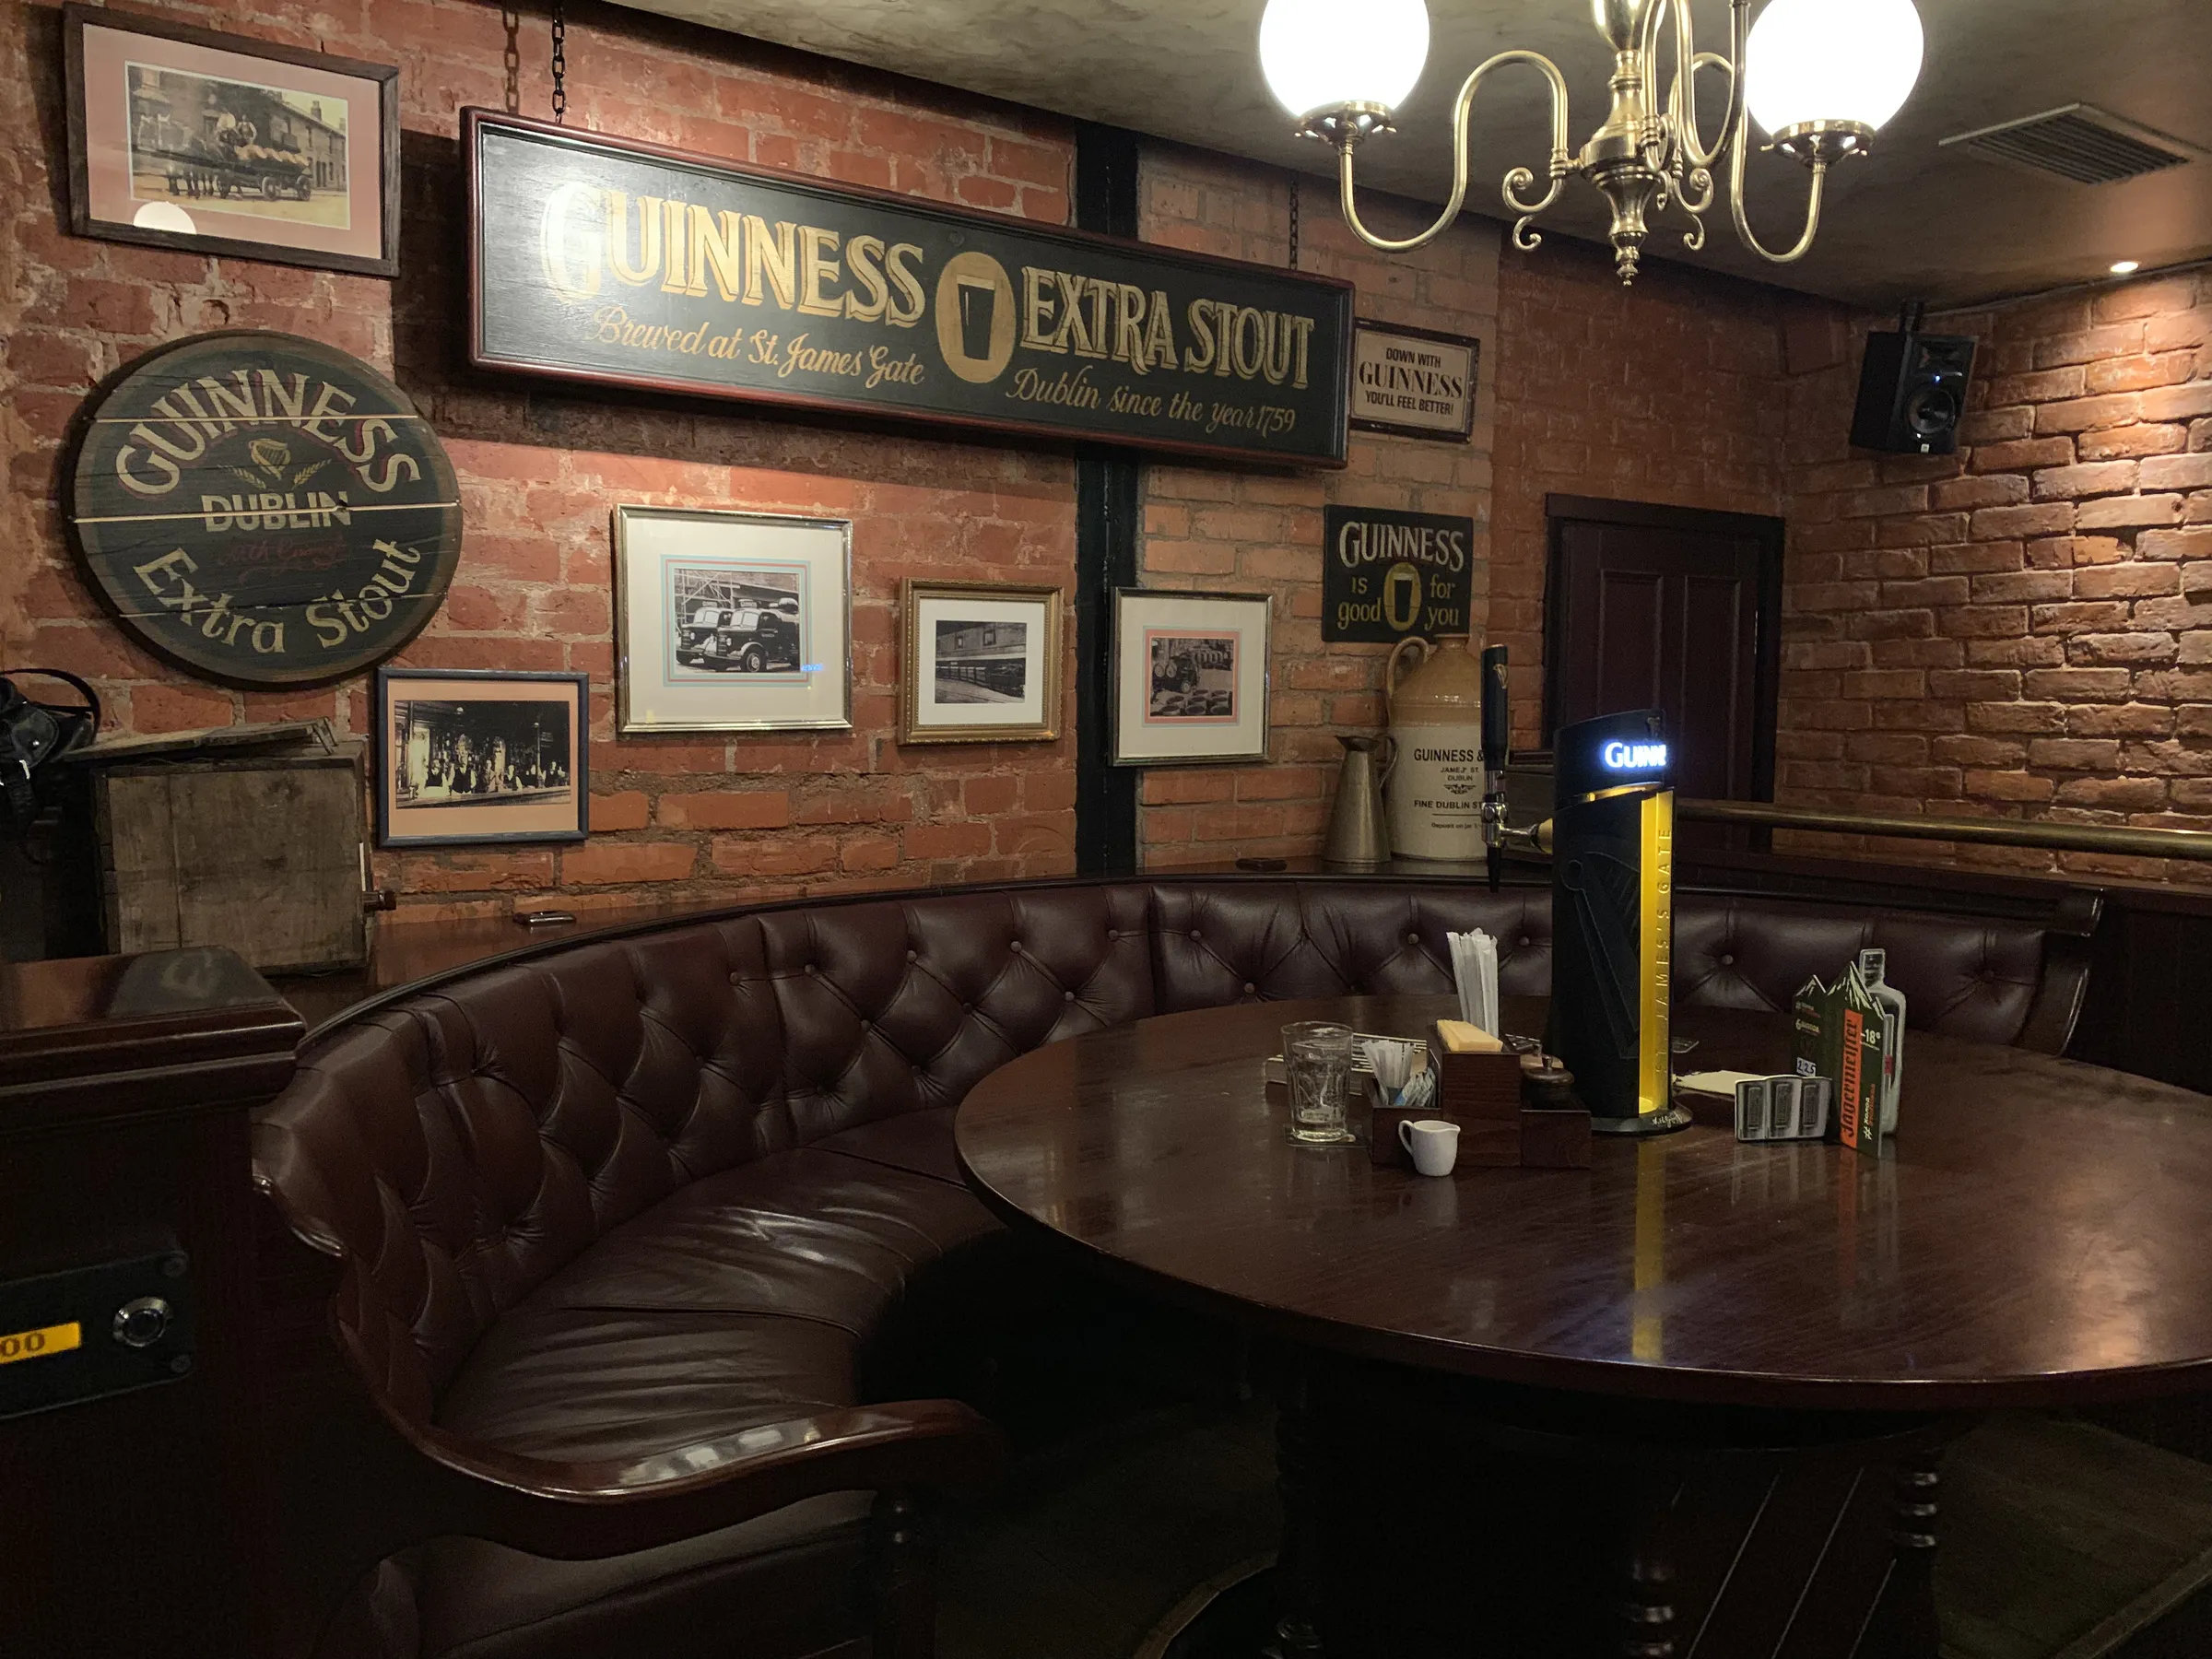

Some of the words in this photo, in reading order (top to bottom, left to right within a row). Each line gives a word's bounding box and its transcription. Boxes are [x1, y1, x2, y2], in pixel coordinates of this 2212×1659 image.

[540, 172, 925, 329] GUINNESS
[1020, 265, 1178, 375] EXTRA
[1183, 298, 1314, 390] STOUT
[586, 304, 709, 355] Brewed
[708, 327, 743, 359] at
[1385, 347, 1416, 364] DOWN
[1418, 352, 1441, 369] WITH
[1359, 360, 1463, 400] GUINNESS
[1006, 364, 1101, 409] Dublin
[1106, 385, 1162, 417] since
[1168, 392, 1204, 421] the
[1205, 401, 1255, 434] year
[1258, 406, 1296, 439] 1759
[1365, 390, 1395, 407] YOU'LL
[1397, 394, 1417, 410] FEEL
[1418, 398, 1453, 416] BETTER!
[115, 369, 421, 495] GUINNESS
[201, 490, 352, 532] DUBLIN
[1339, 521, 1465, 572] GUINNESS
[133, 547, 286, 653] Extra
[305, 538, 421, 649] Stout
[1430, 573, 1455, 599] for
[1337, 597, 1382, 630] good
[1424, 606, 1460, 631] you
[1414, 747, 1475, 762] GUINNESS
[1436, 801, 1470, 809] DUBLIN
[1657, 830, 1671, 894] GATE
